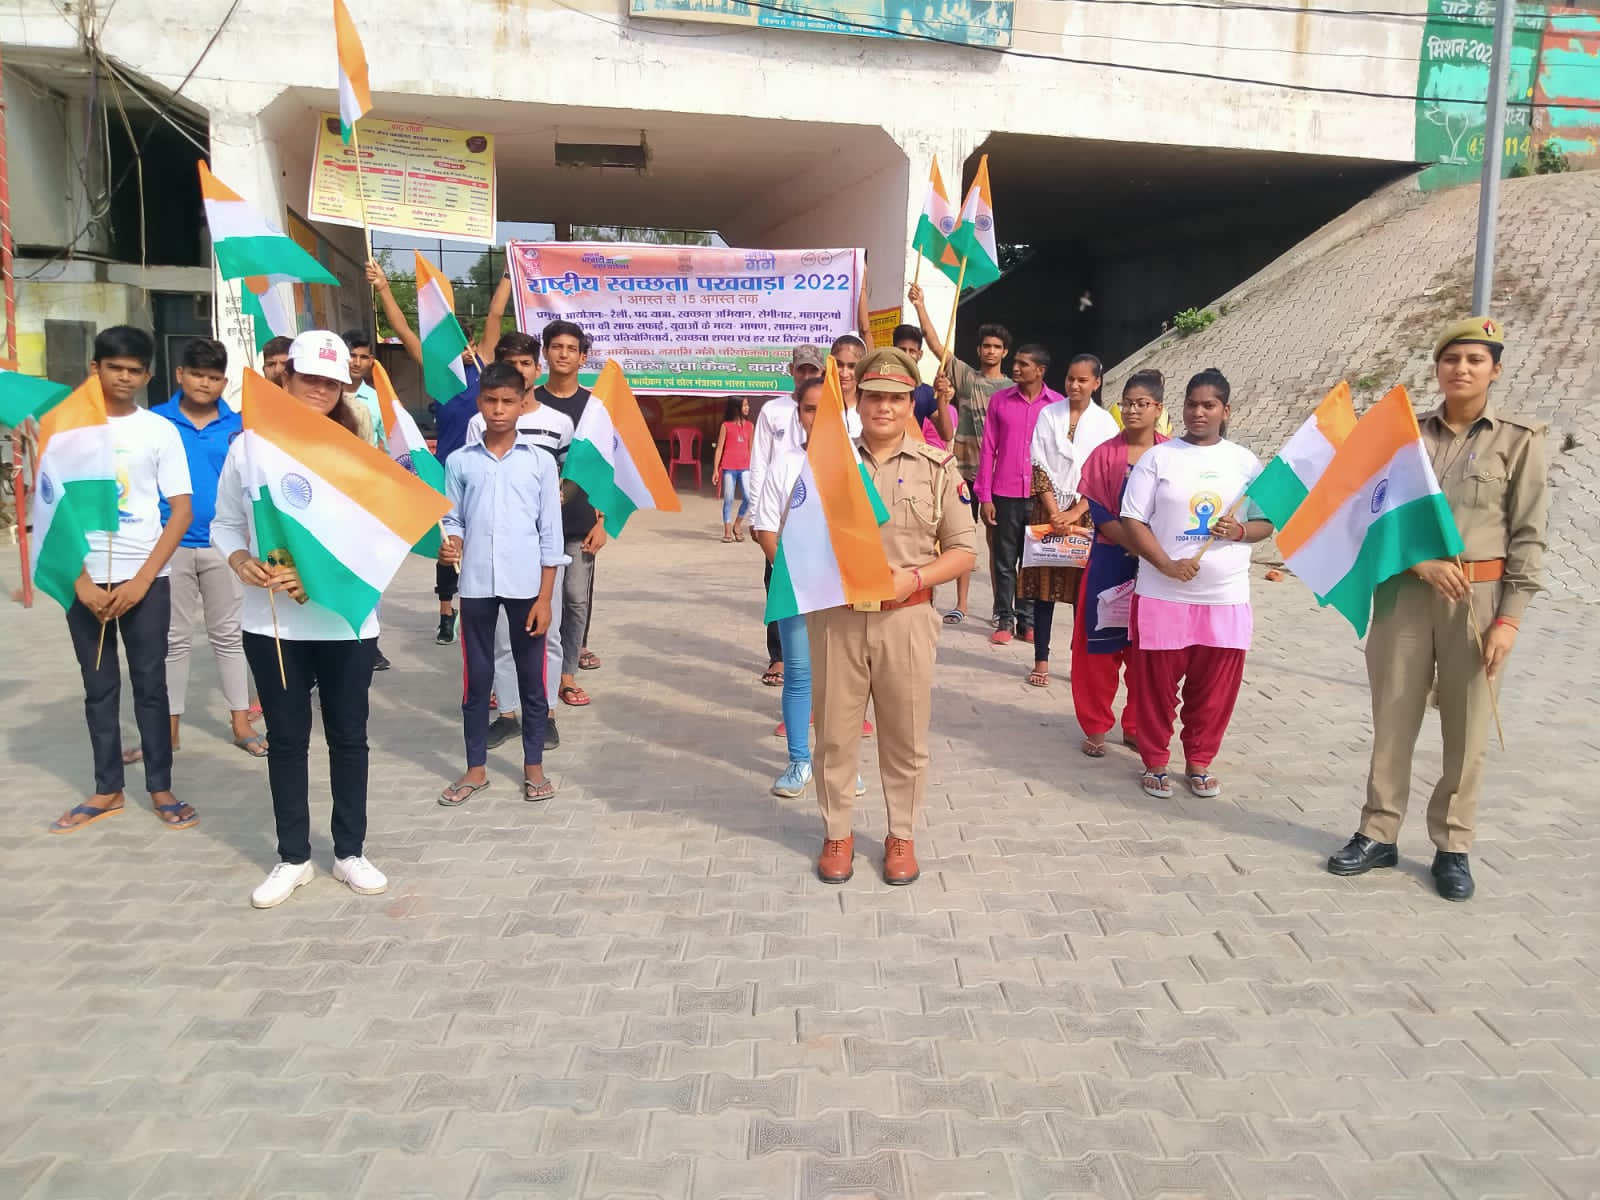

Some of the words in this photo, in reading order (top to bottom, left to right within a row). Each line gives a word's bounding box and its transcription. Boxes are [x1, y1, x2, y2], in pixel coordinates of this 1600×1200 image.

[1427, 36, 1494, 61] मिशन-202
[526, 272, 599, 295] राष्ट्रीय
[605, 276, 688, 292] स्वच्छता
[696, 276, 785, 295] पखवाड़ा
[794, 274, 849, 290] 2022
[627, 296, 662, 304] अगस्त
[666, 293, 676, 304] से
[683, 295, 696, 303] 15
[700, 294, 735, 304] अगस्त
[738, 294, 758, 304] तक
[669, 362, 696, 373] युवा
